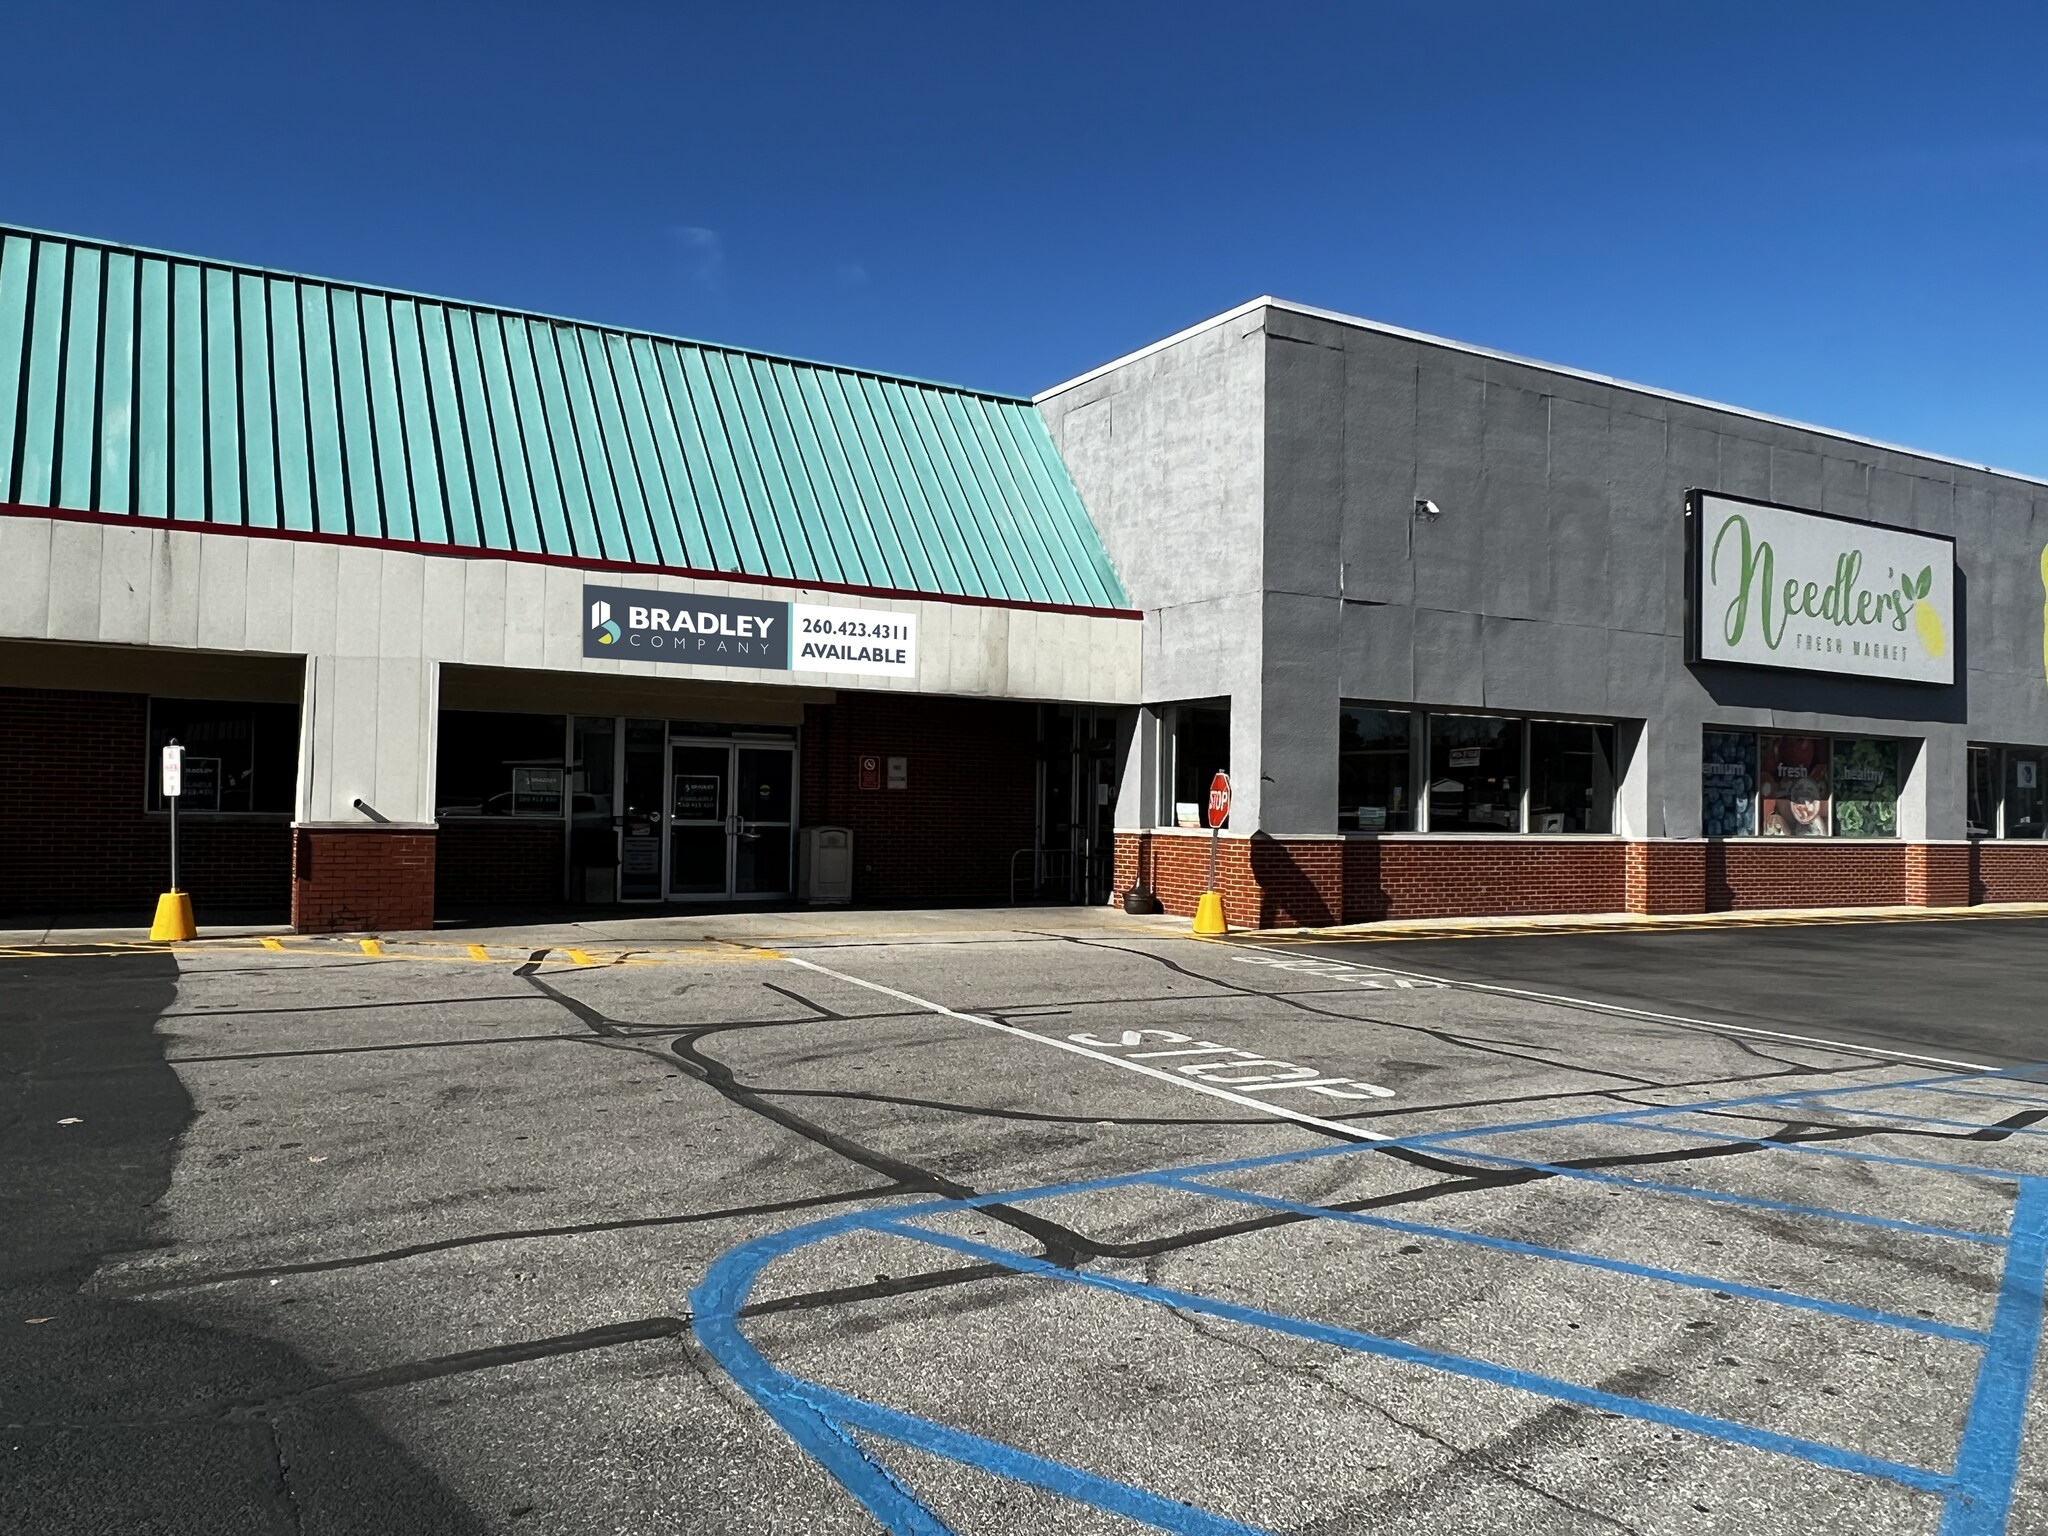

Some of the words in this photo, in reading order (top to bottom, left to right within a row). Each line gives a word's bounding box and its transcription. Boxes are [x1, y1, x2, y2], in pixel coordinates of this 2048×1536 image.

[1710, 514, 1914, 651] Needler's
[628, 606, 775, 639] BRADLEY
[802, 618, 908, 641] 260.423.4311
[629, 633, 770, 655] COMPANY
[801, 642, 907, 664] AVAILABLE
[1777, 762, 1809, 778] fresh
[1844, 765, 1884, 786] healthy
[1209, 790, 1228, 811] STOP
[1067, 1029, 1396, 1099] STOP
